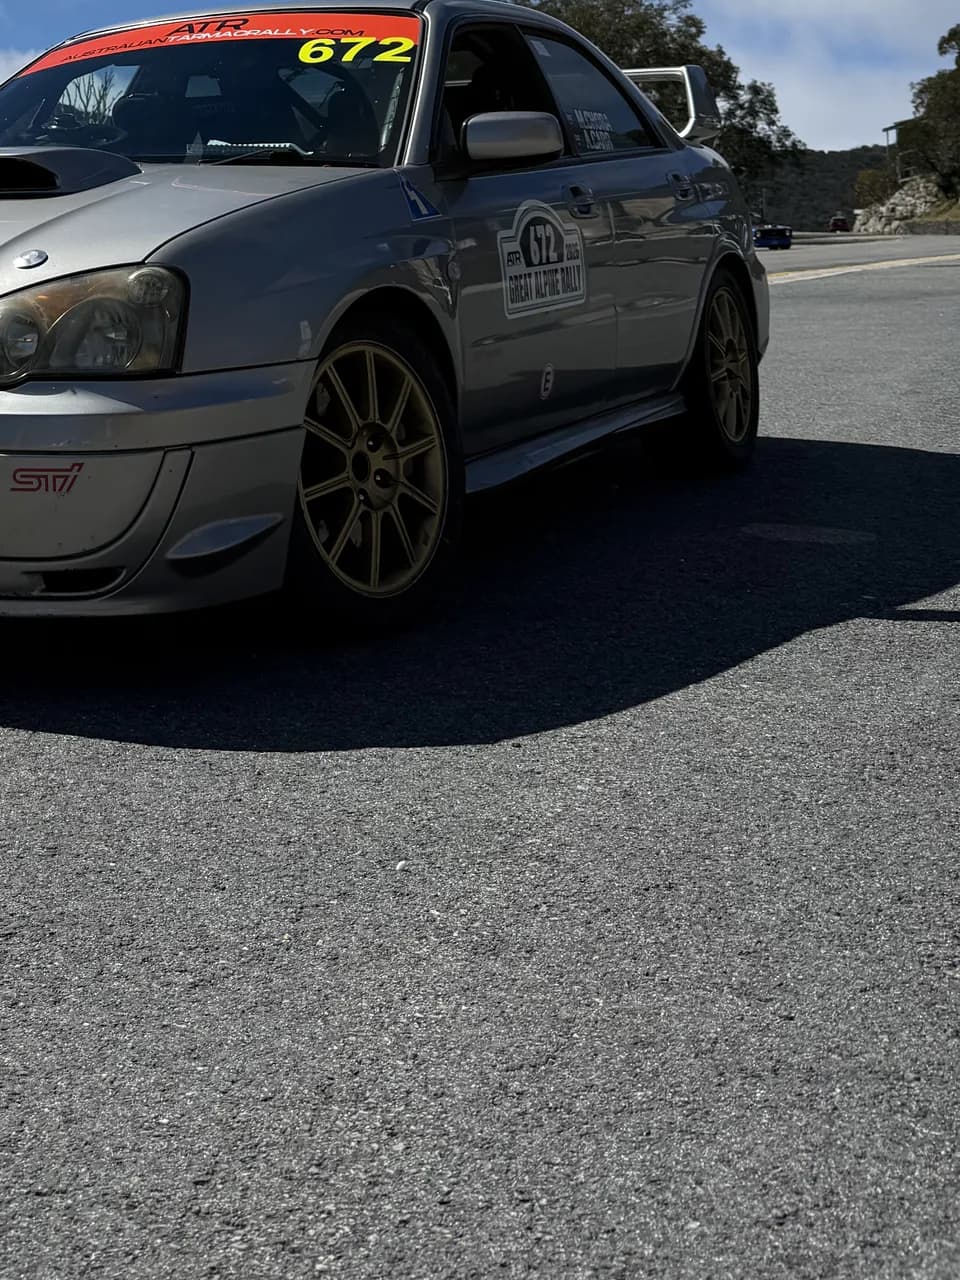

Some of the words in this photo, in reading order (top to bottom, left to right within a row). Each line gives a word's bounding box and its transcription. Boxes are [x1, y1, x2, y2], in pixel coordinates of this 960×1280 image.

[165, 18, 250, 36] ATR
[297, 35, 415, 64] 672
[529, 224, 559, 266] 672
[509, 272, 533, 304] GREAT
[534, 268, 560, 299] ALPINE
[560, 264, 582, 294] RALLY
[543, 371, 551, 393] E
